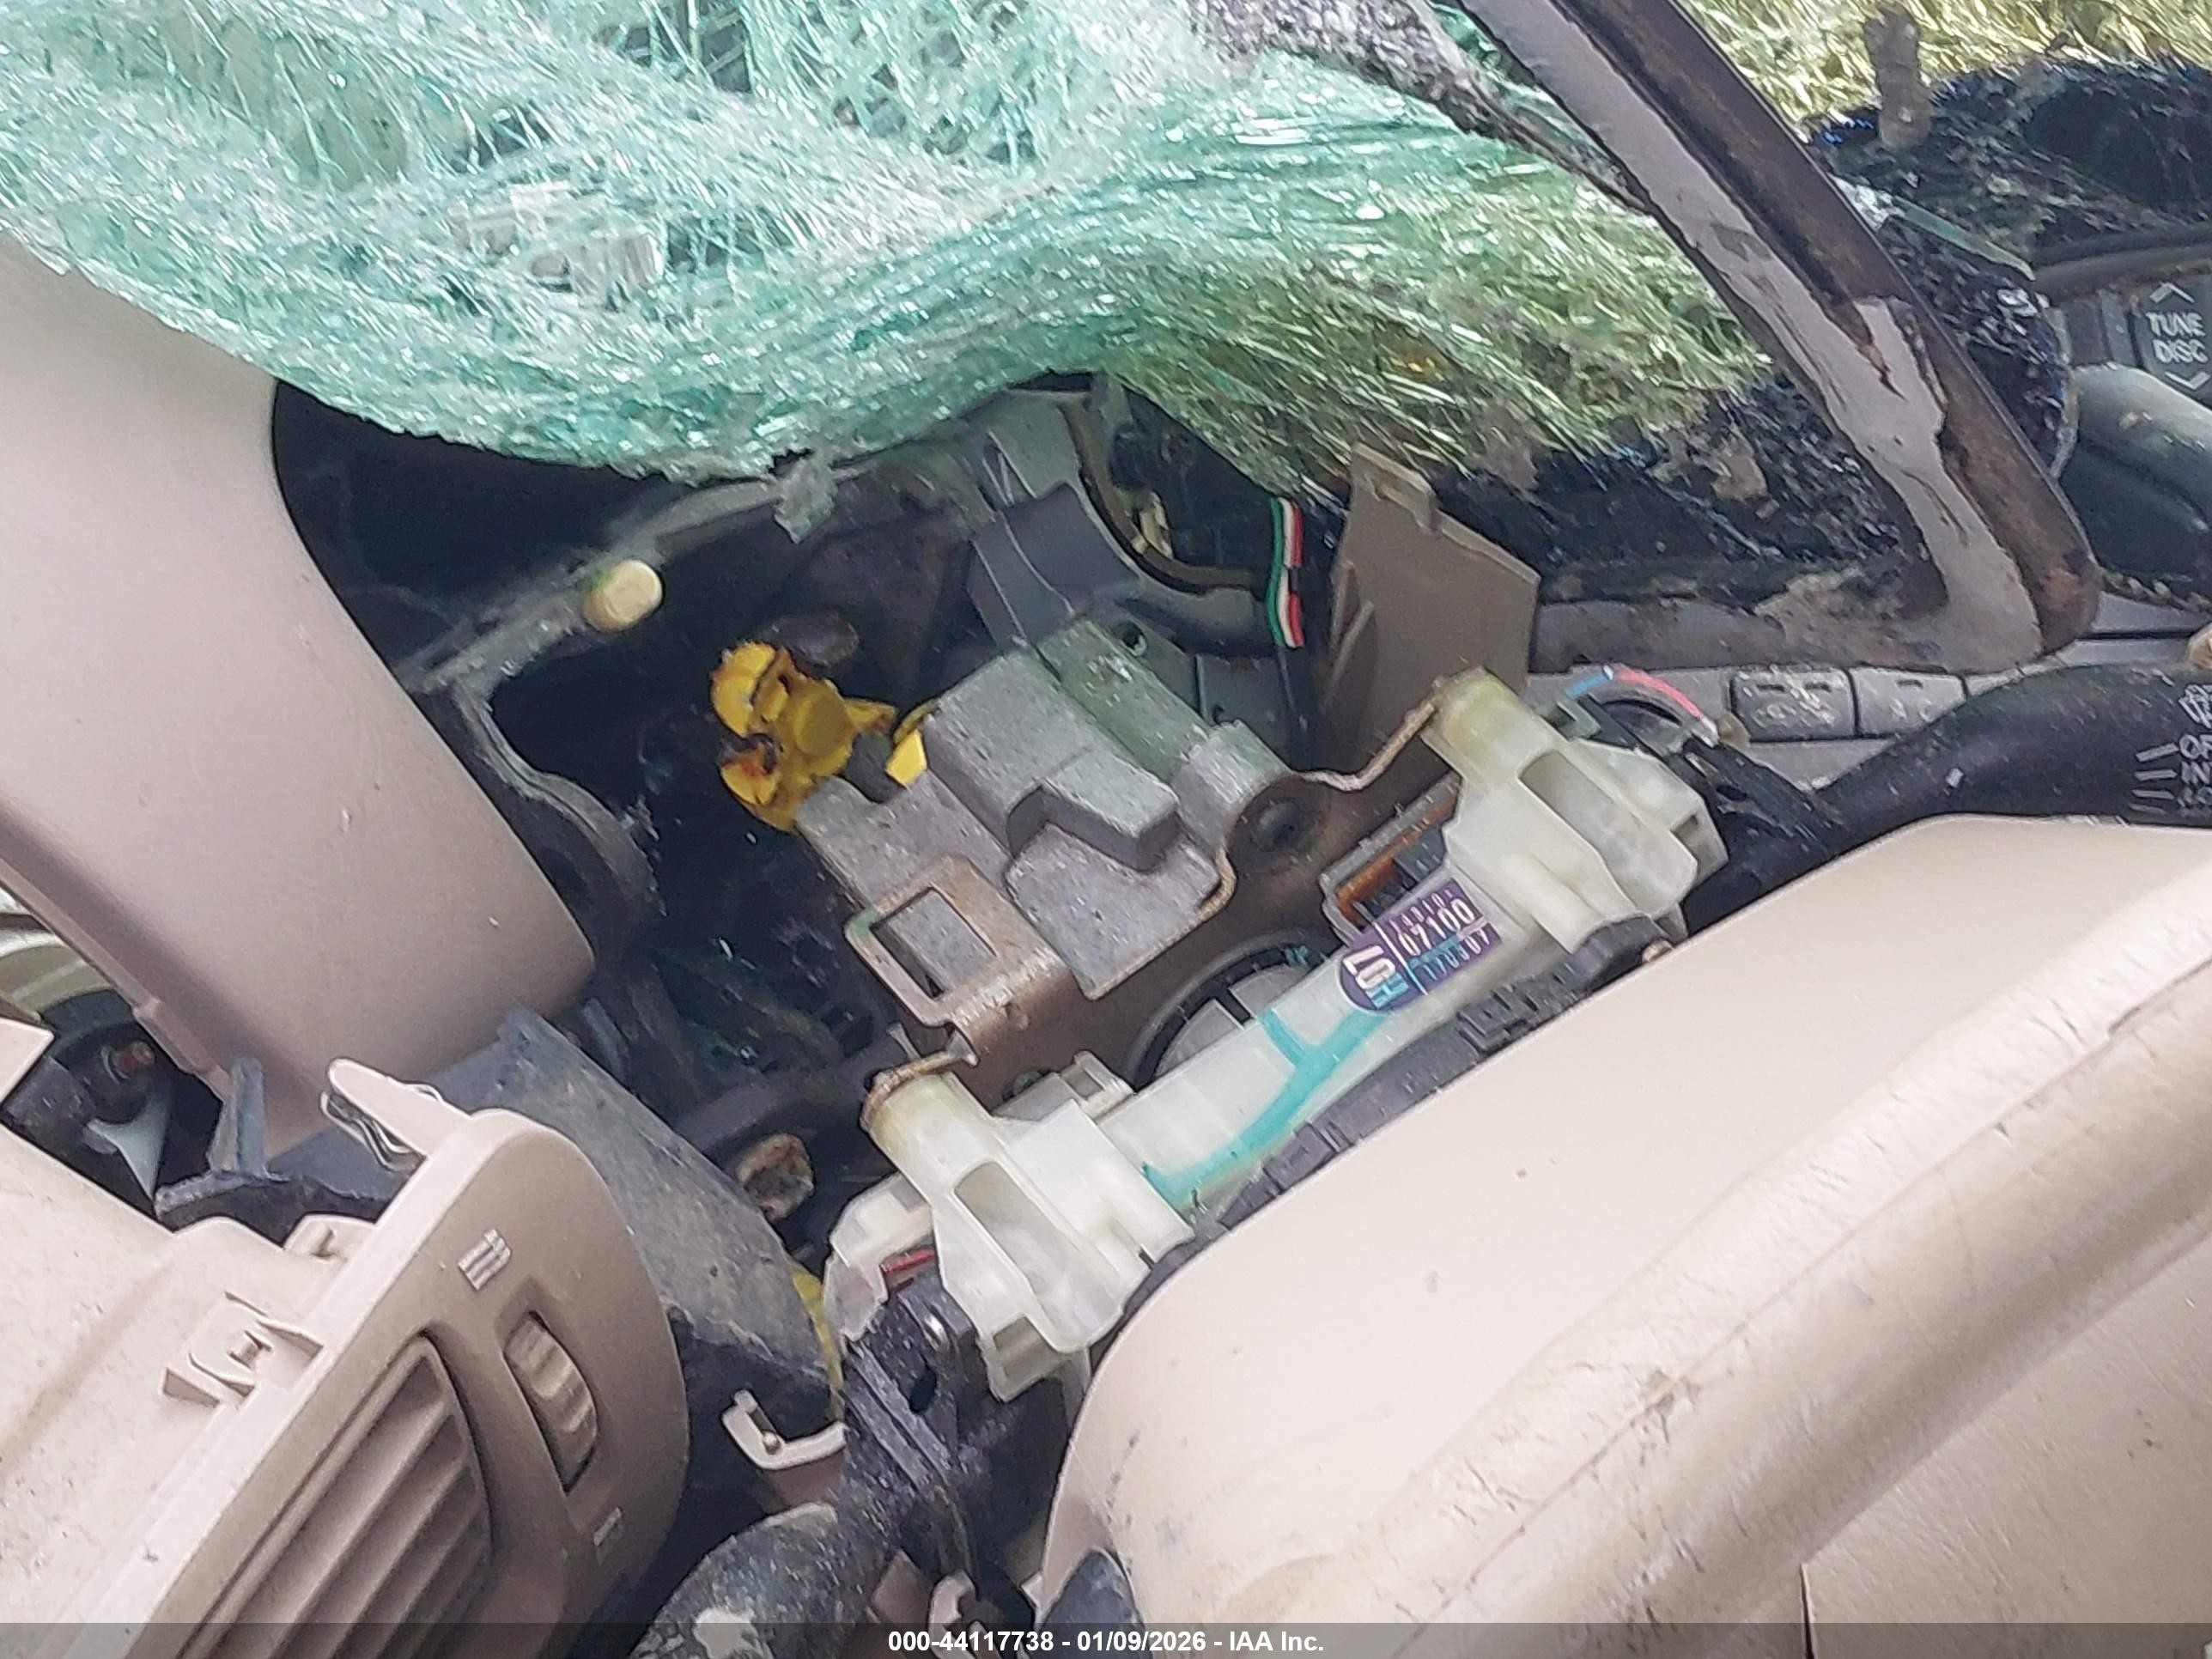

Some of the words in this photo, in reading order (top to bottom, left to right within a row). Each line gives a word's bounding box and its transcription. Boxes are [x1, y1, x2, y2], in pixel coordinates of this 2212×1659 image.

[2145, 312, 2206, 337] TUNE
[2152, 339, 2209, 363] DISC
[1397, 898, 1475, 957] 07100
